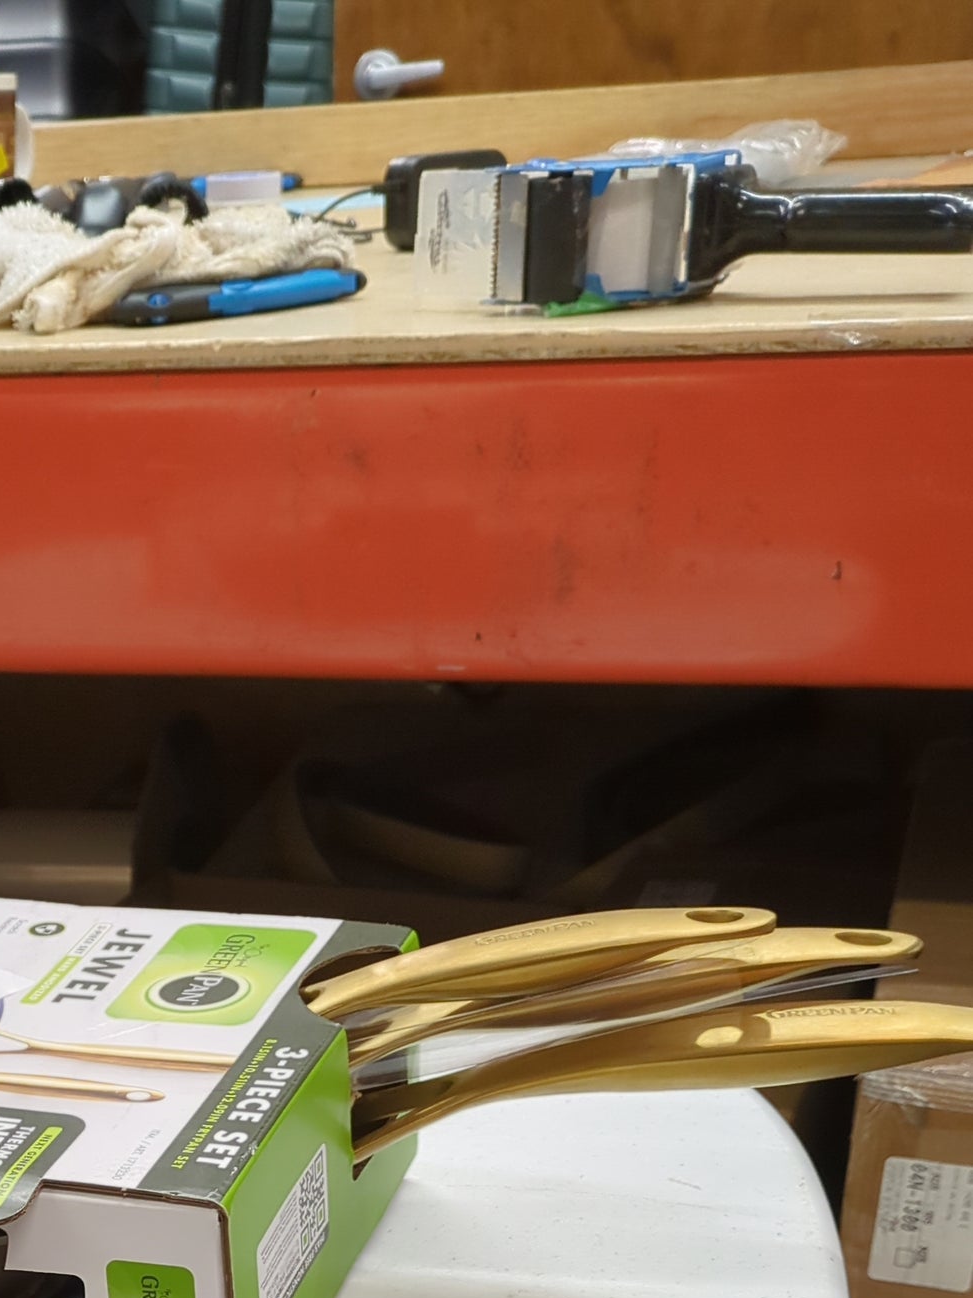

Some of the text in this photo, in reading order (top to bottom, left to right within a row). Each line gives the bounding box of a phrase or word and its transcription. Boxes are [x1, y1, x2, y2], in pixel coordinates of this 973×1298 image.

[51, 928, 153, 1003] JEWEL
[227, 1046, 309, 1124] 3-PIECE
[182, 1124, 214, 1154] FRYPAN
[196, 1130, 249, 1169] SET
[171, 1153, 190, 1169] SET
